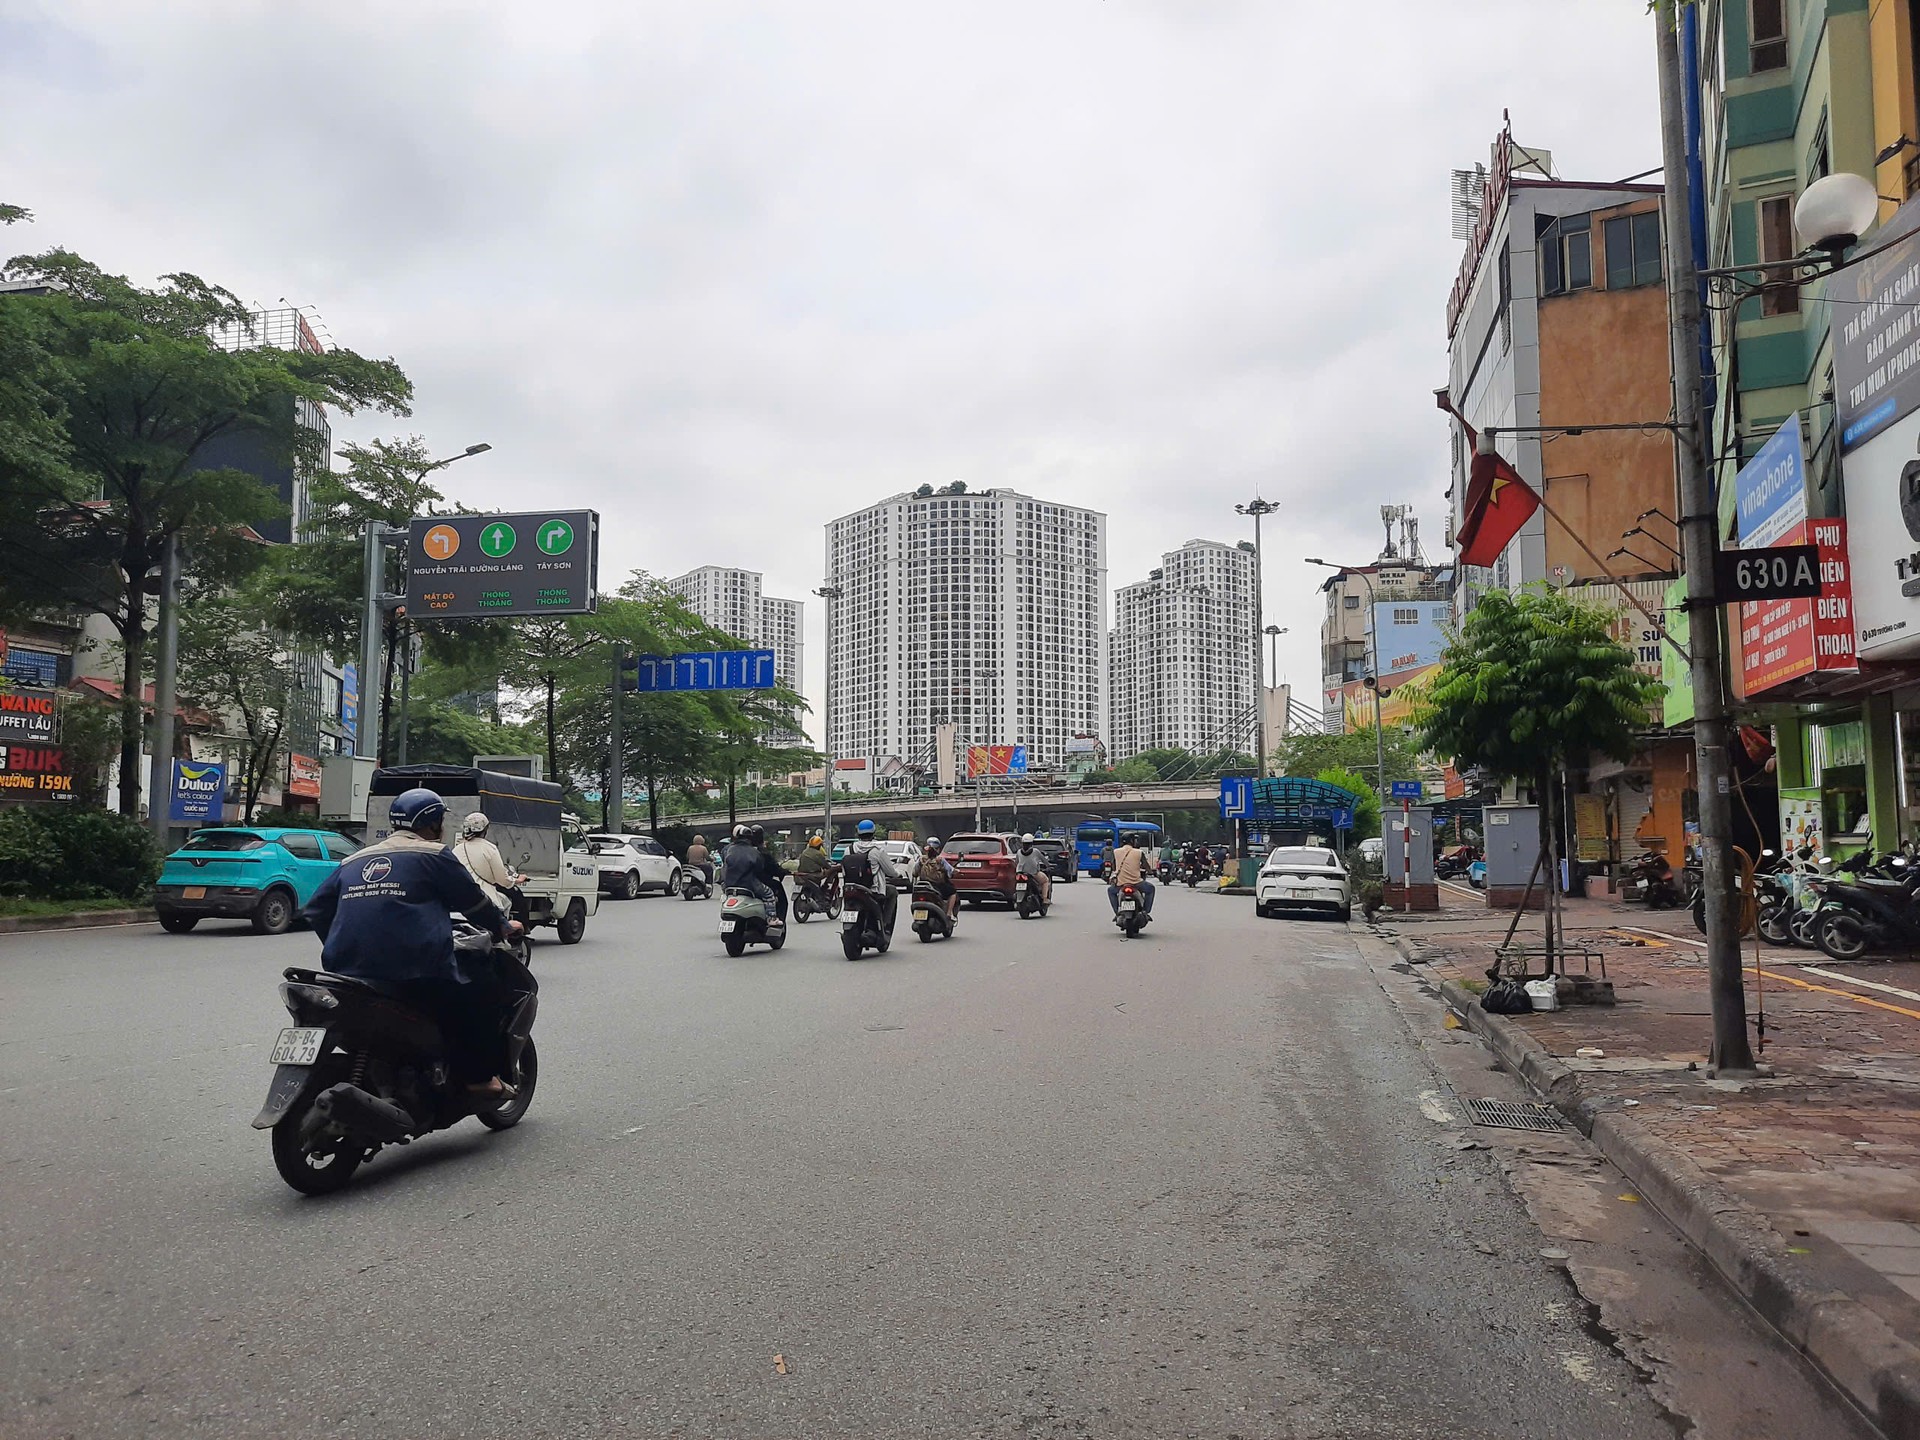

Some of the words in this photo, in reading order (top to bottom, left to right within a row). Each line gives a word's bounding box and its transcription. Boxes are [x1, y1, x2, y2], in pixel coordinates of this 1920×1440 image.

[1885, 311, 1911, 349] HÀNH
[1849, 381, 1866, 409] THU
[1867, 365, 1886, 397] MUA
[1742, 453, 1794, 519] vinaphone
[1815, 525, 1841, 551] PHỤ
[413, 565, 447, 575] NGUYỄN
[470, 563, 499, 573] ĐƯỜNG
[501, 562, 524, 572] LÁNG
[536, 561, 552, 570] TÂY
[553, 561, 572, 570] SƠN
[430, 601, 448, 609] CAO
[479, 599, 513, 608] THOÁNG
[536, 597, 571, 606] THOÁNG
[1817, 594, 1848, 624] ĐIỆN
[1817, 633, 1853, 660] THOẠI
[29, 714, 52, 730] LẨU
[39, 774, 73, 790] 159K
[179, 776, 215, 791] Dulux
[177, 791, 191, 799] let's
[192, 792, 214, 800] colour
[572, 867, 594, 876] SUZUKI
[273, 1046, 316, 1063] 604.79
